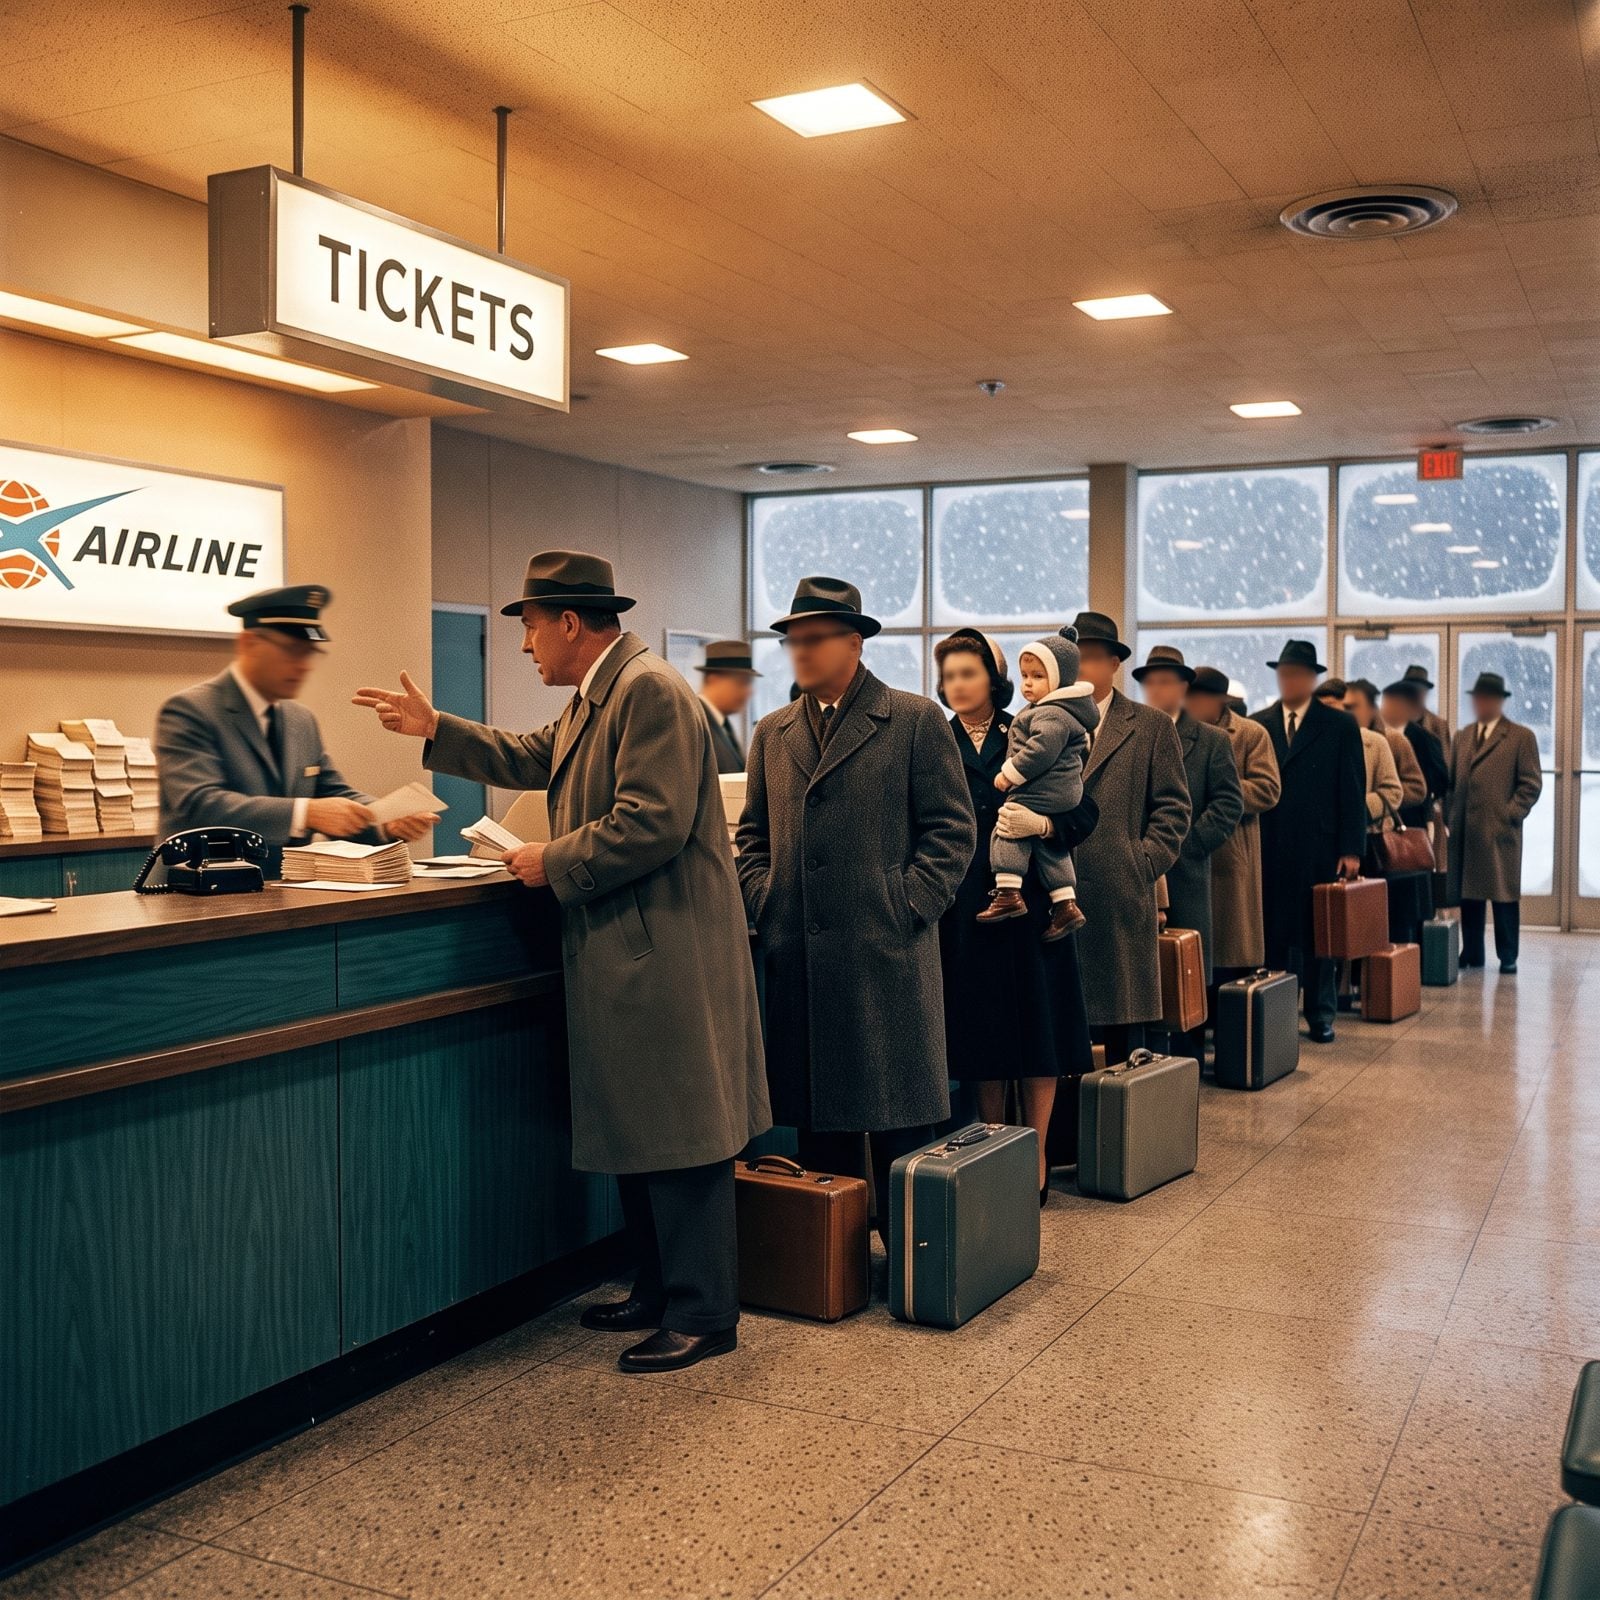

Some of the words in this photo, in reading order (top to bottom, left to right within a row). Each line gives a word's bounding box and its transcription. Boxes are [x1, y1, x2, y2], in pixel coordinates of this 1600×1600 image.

[318, 234, 535, 361] TICKETS
[1423, 452, 1457, 478] EXIT
[72, 525, 263, 579] AIRLINE
